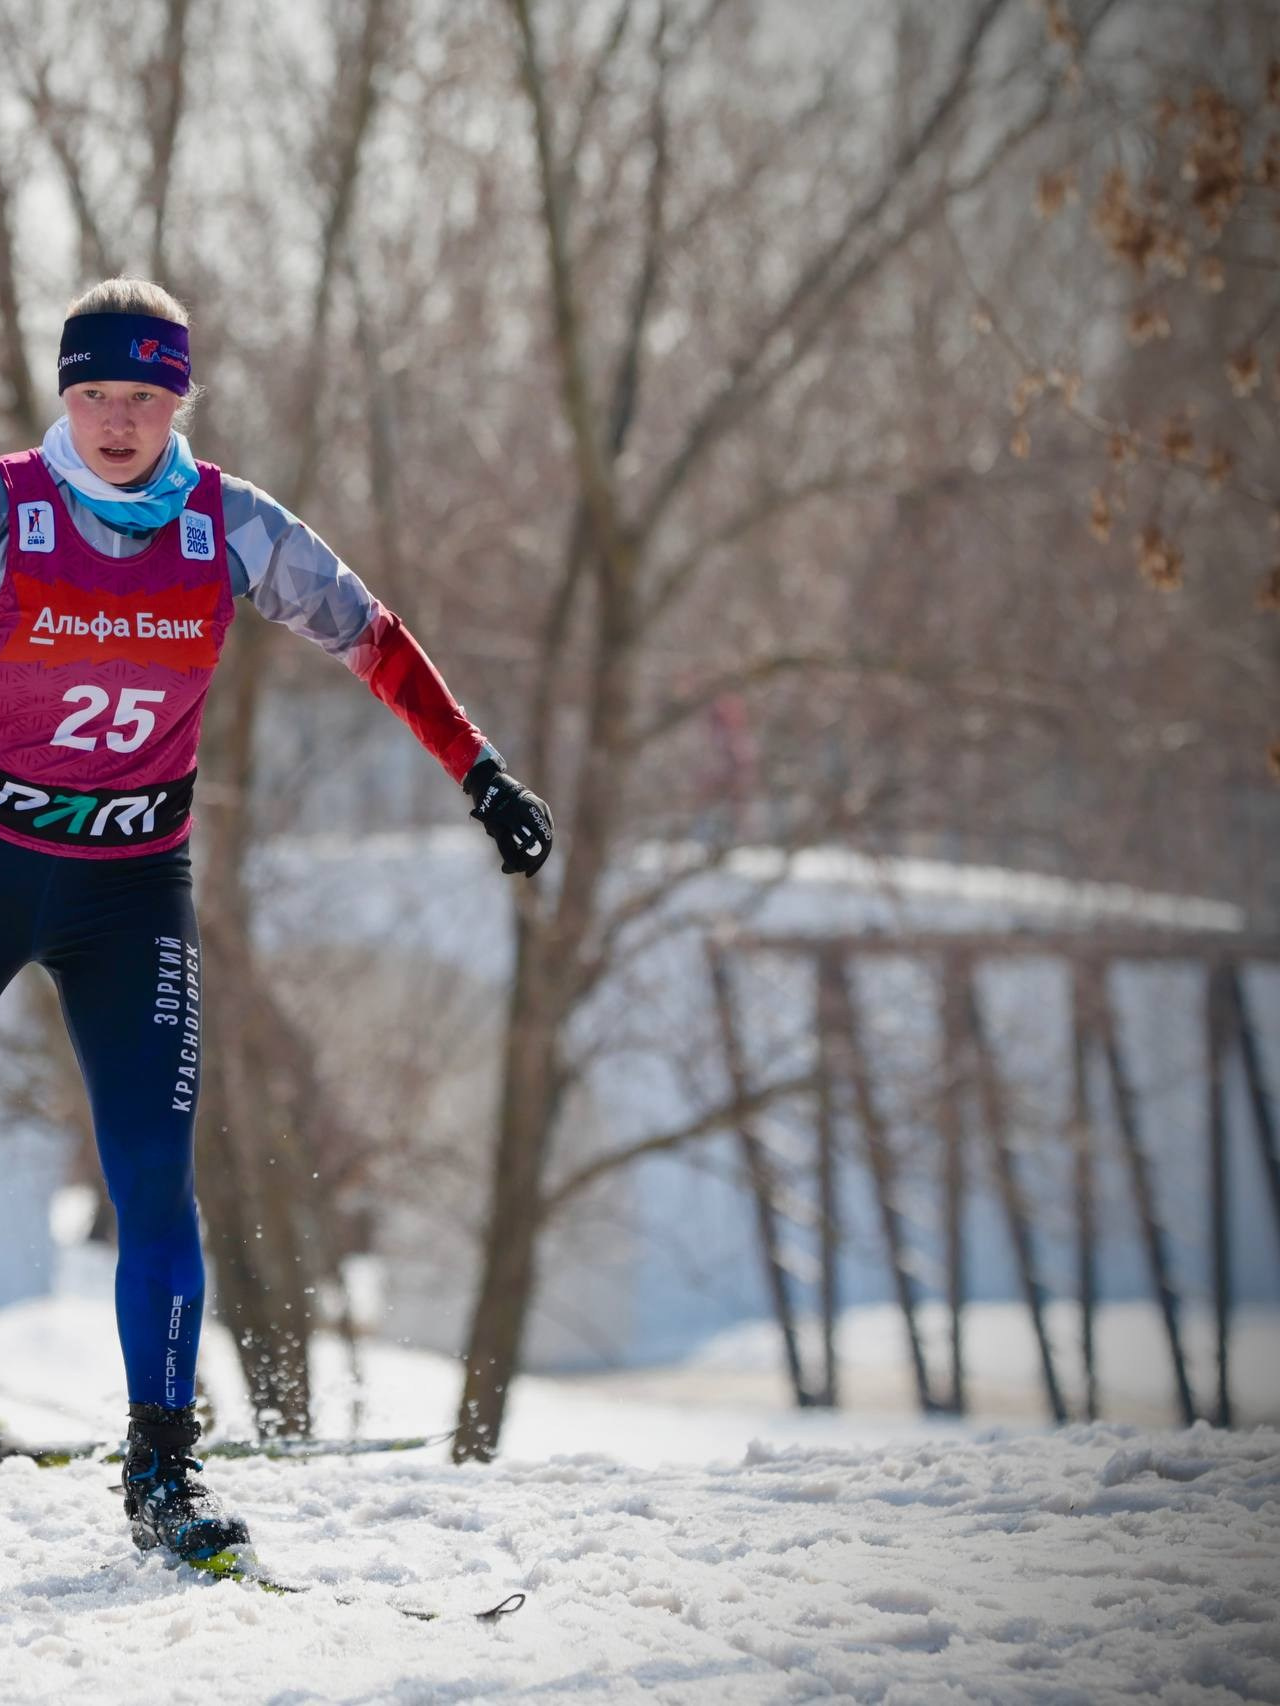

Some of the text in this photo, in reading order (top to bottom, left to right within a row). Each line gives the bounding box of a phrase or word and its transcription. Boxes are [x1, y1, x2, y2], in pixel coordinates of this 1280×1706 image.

[61, 352, 91, 366] Rostec
[186, 526, 207, 542] 2024
[187, 539, 209, 555] 2025
[29, 607, 203, 645] Альфа Банк
[50, 685, 166, 753] 25
[529, 806, 551, 841] adidas
[154, 936, 182, 1025] ЗОРКИЙ
[172, 943, 199, 1113] КРАСНОГОРСК
[168, 1295, 184, 1340] CODE
